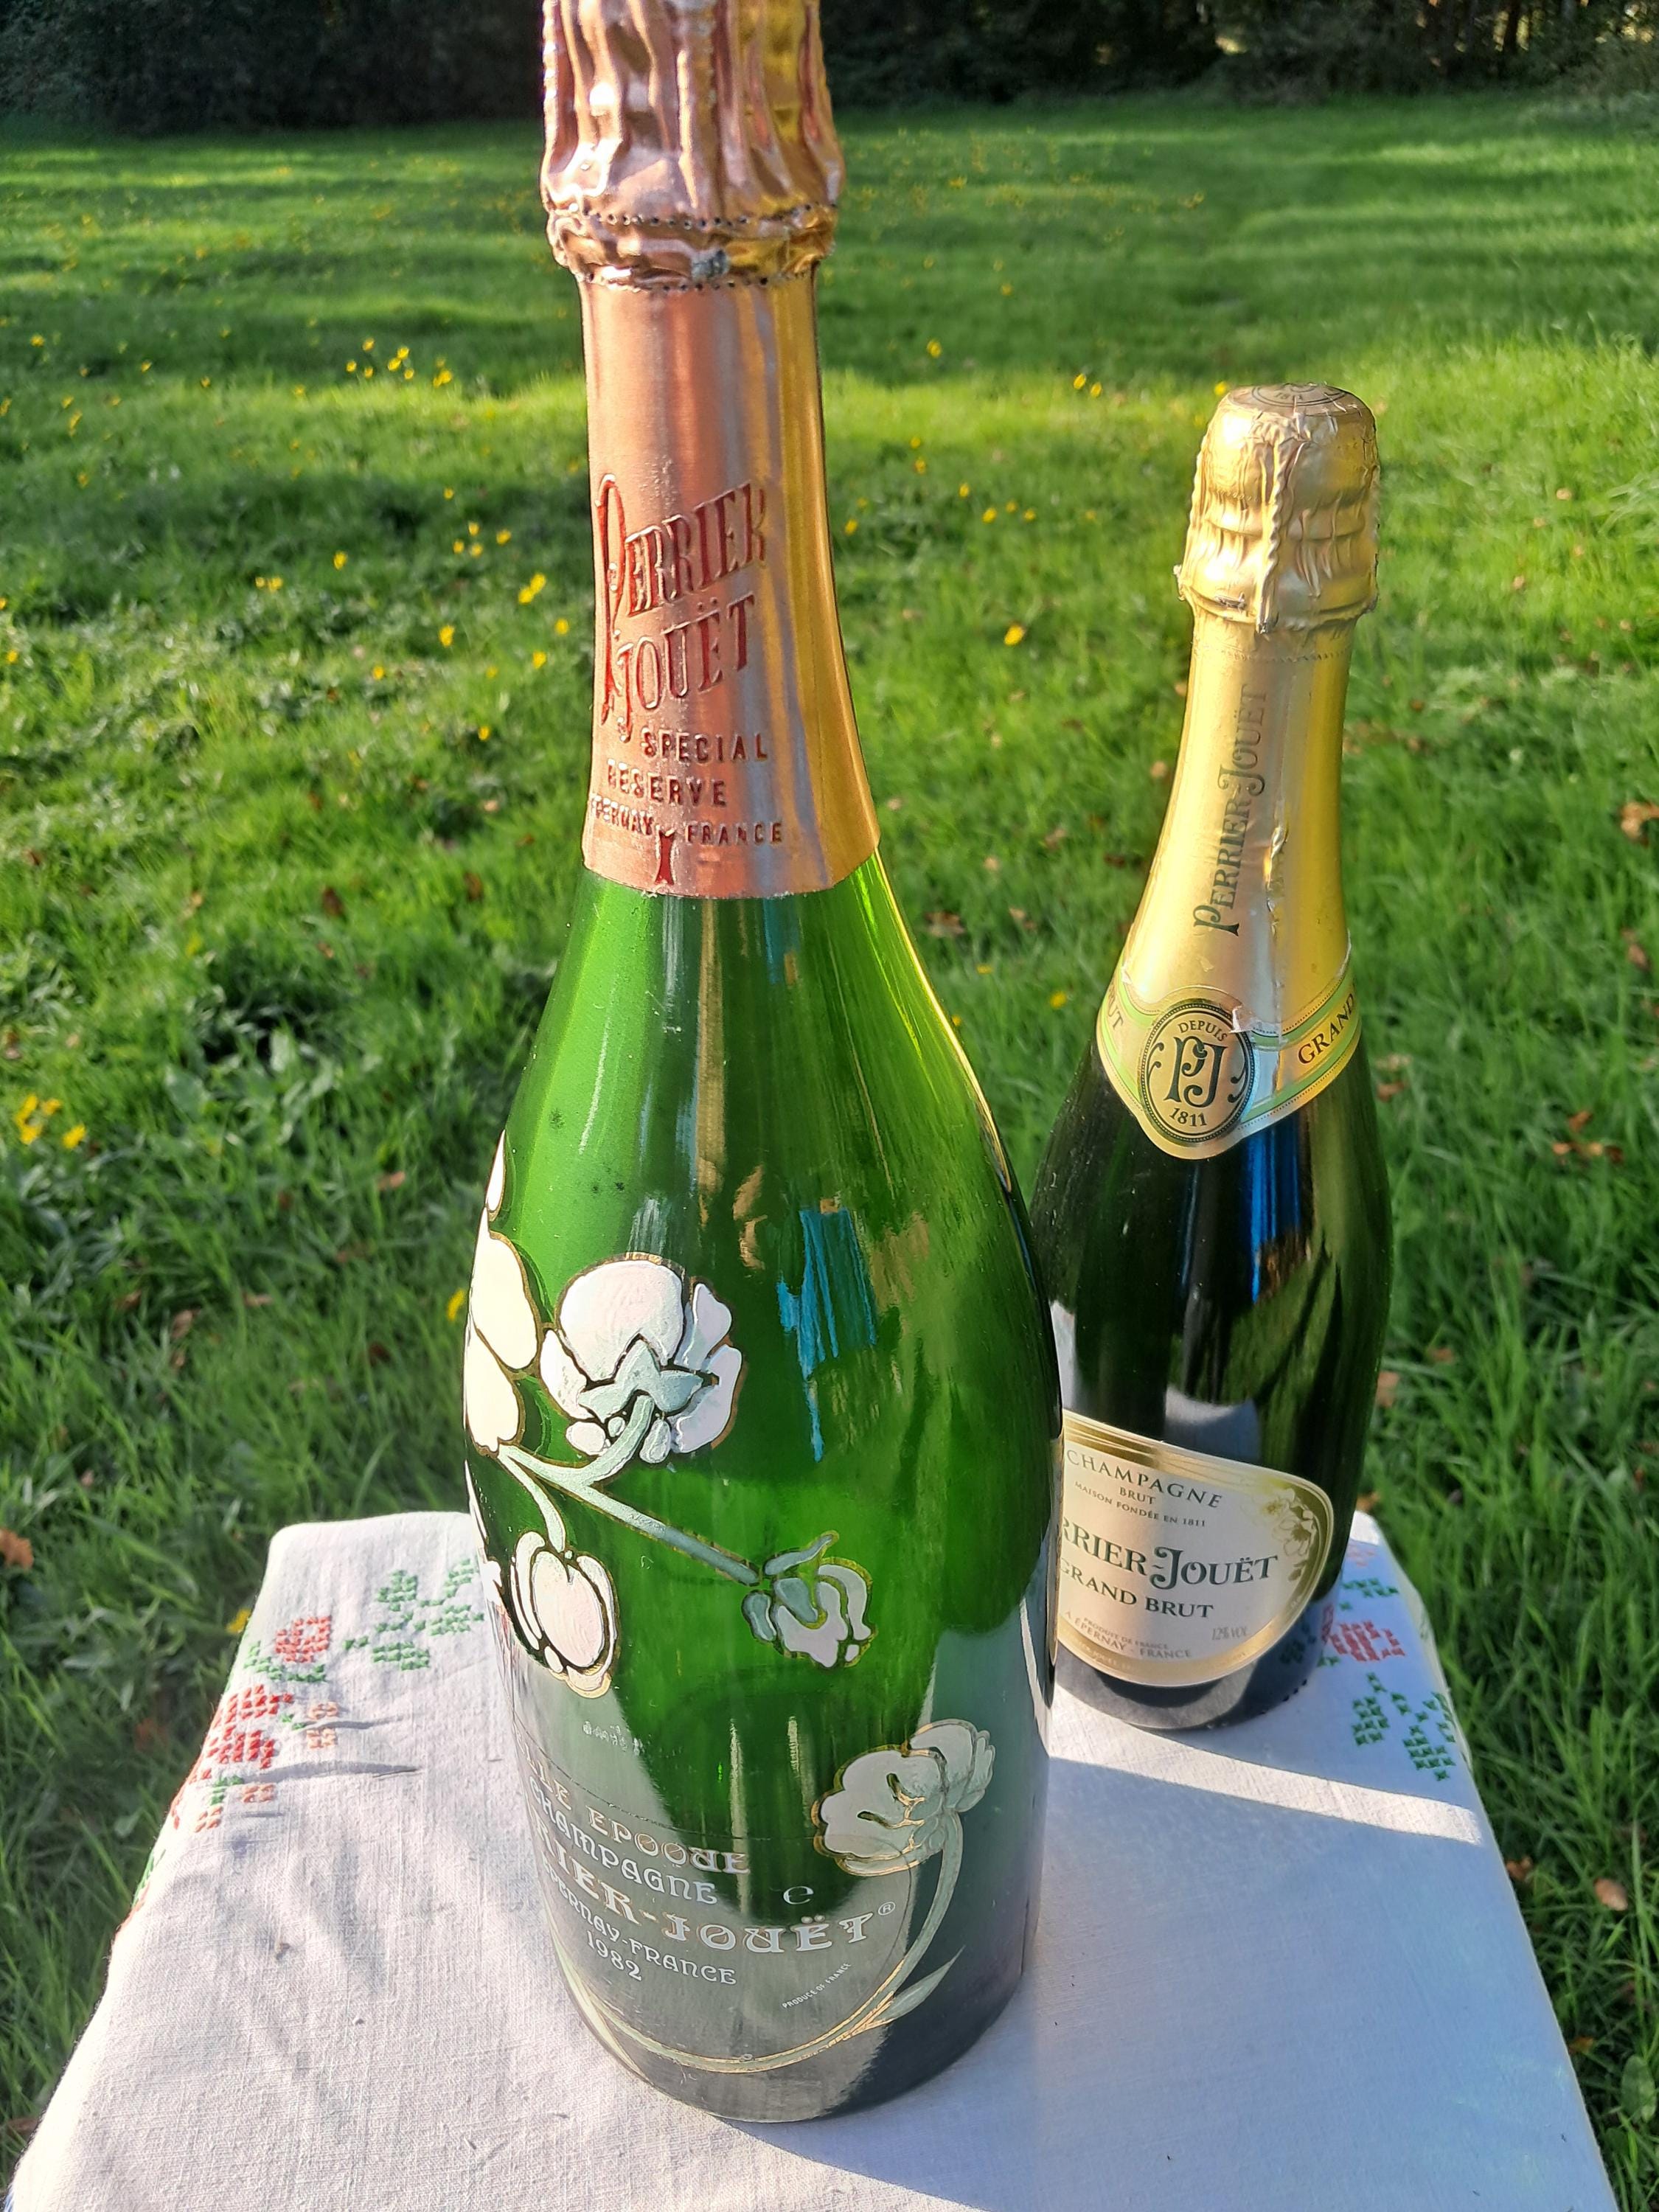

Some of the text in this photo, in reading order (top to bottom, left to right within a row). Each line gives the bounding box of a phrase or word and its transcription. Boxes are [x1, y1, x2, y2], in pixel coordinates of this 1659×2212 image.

[595, 473, 766, 726] PERRIER
[641, 727, 768, 762] SPECIAL
[608, 759, 728, 807] RESERVE
[591, 794, 782, 845] PERNAY FRANCE
[1179, 1020, 1228, 1043] DEPUIS
[1298, 992, 1354, 1065] GRAND
[1169, 1107, 1208, 1127] 1811
[1066, 1449, 1222, 1509] CHAMPAGNE
[1119, 1486, 1157, 1506] BRUT
[1075, 1481, 1206, 1528] MAISON FONDÉE EN 1811
[1060, 1557, 1214, 1618] GRAND BRUT
[1121, 1636, 1133, 1645] DE
[1139, 1648, 1192, 1659] FRANCE
[529, 1775, 718, 1905] CHAMPAGNE
[586, 1929, 643, 1982] 1982
[782, 1961, 852, 2010] PRODUCE OF FRANCE
